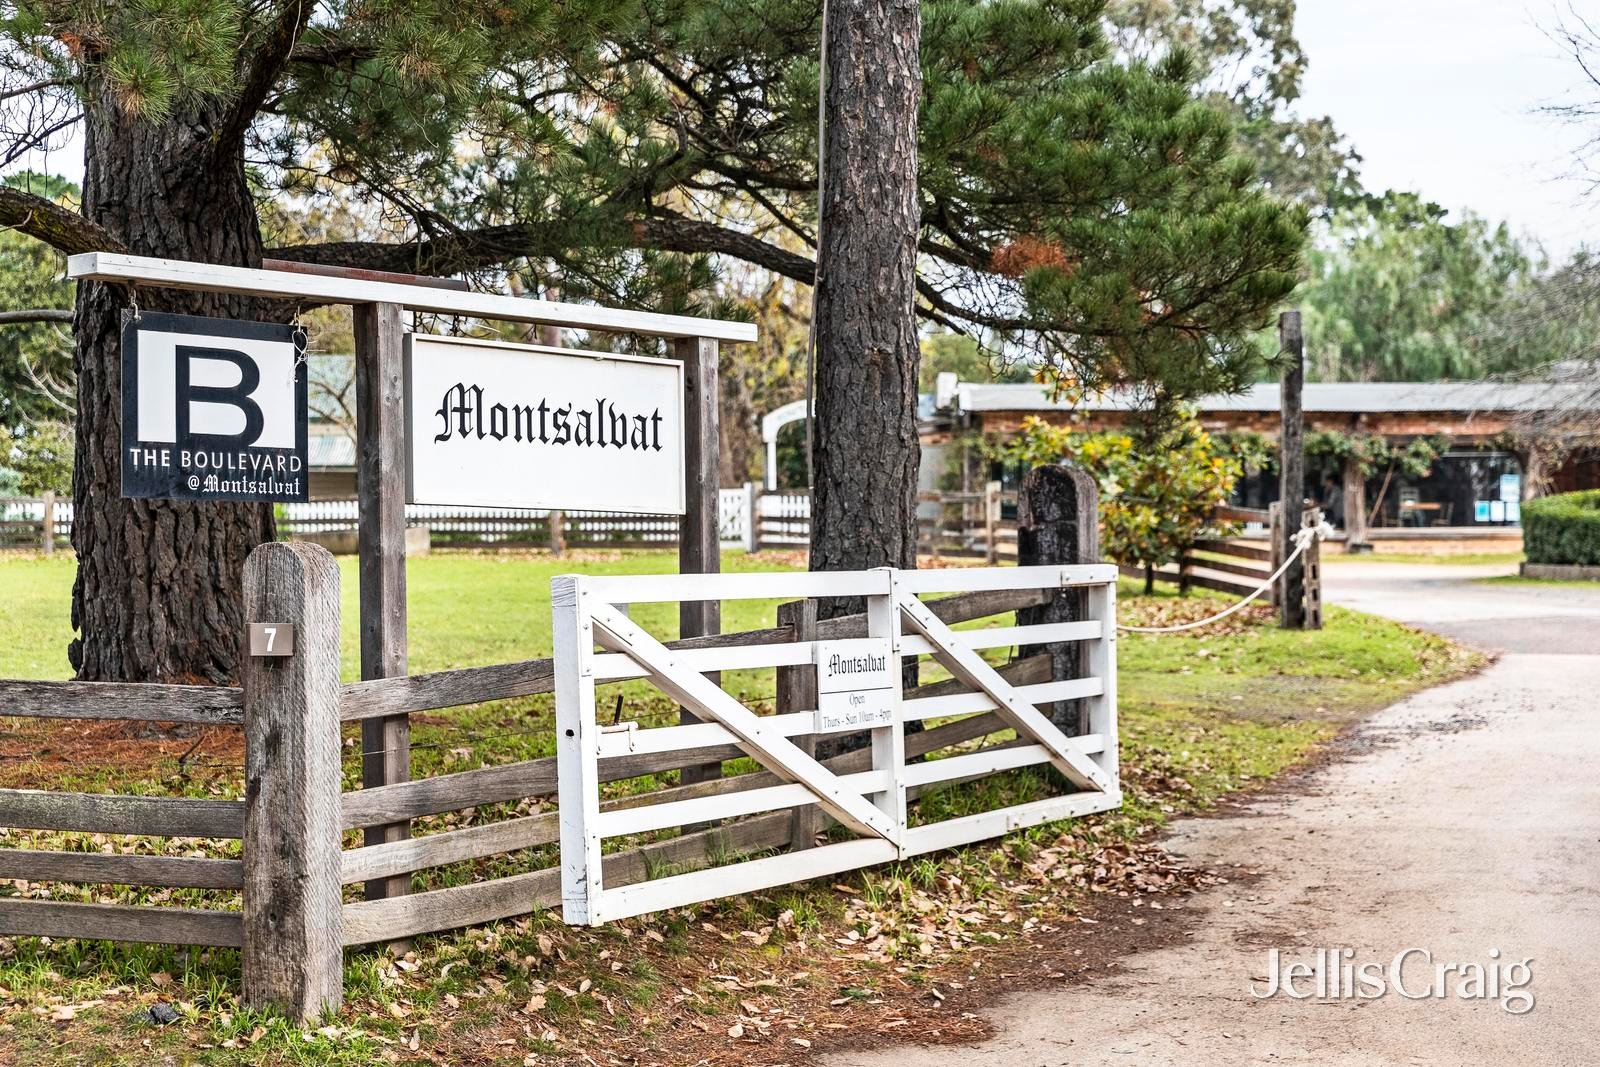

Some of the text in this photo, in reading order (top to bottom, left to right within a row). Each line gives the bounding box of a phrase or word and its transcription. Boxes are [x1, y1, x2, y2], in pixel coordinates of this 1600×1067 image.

[176, 345, 264, 446] B
[434, 382, 663, 452] Montsalvat
[130, 449, 302, 472] THE BOULEVARD
[264, 627, 277, 652] 7
[828, 653, 886, 677] Montsalvat
[849, 693, 865, 708] Open
[846, 713, 857, 725] Sun
